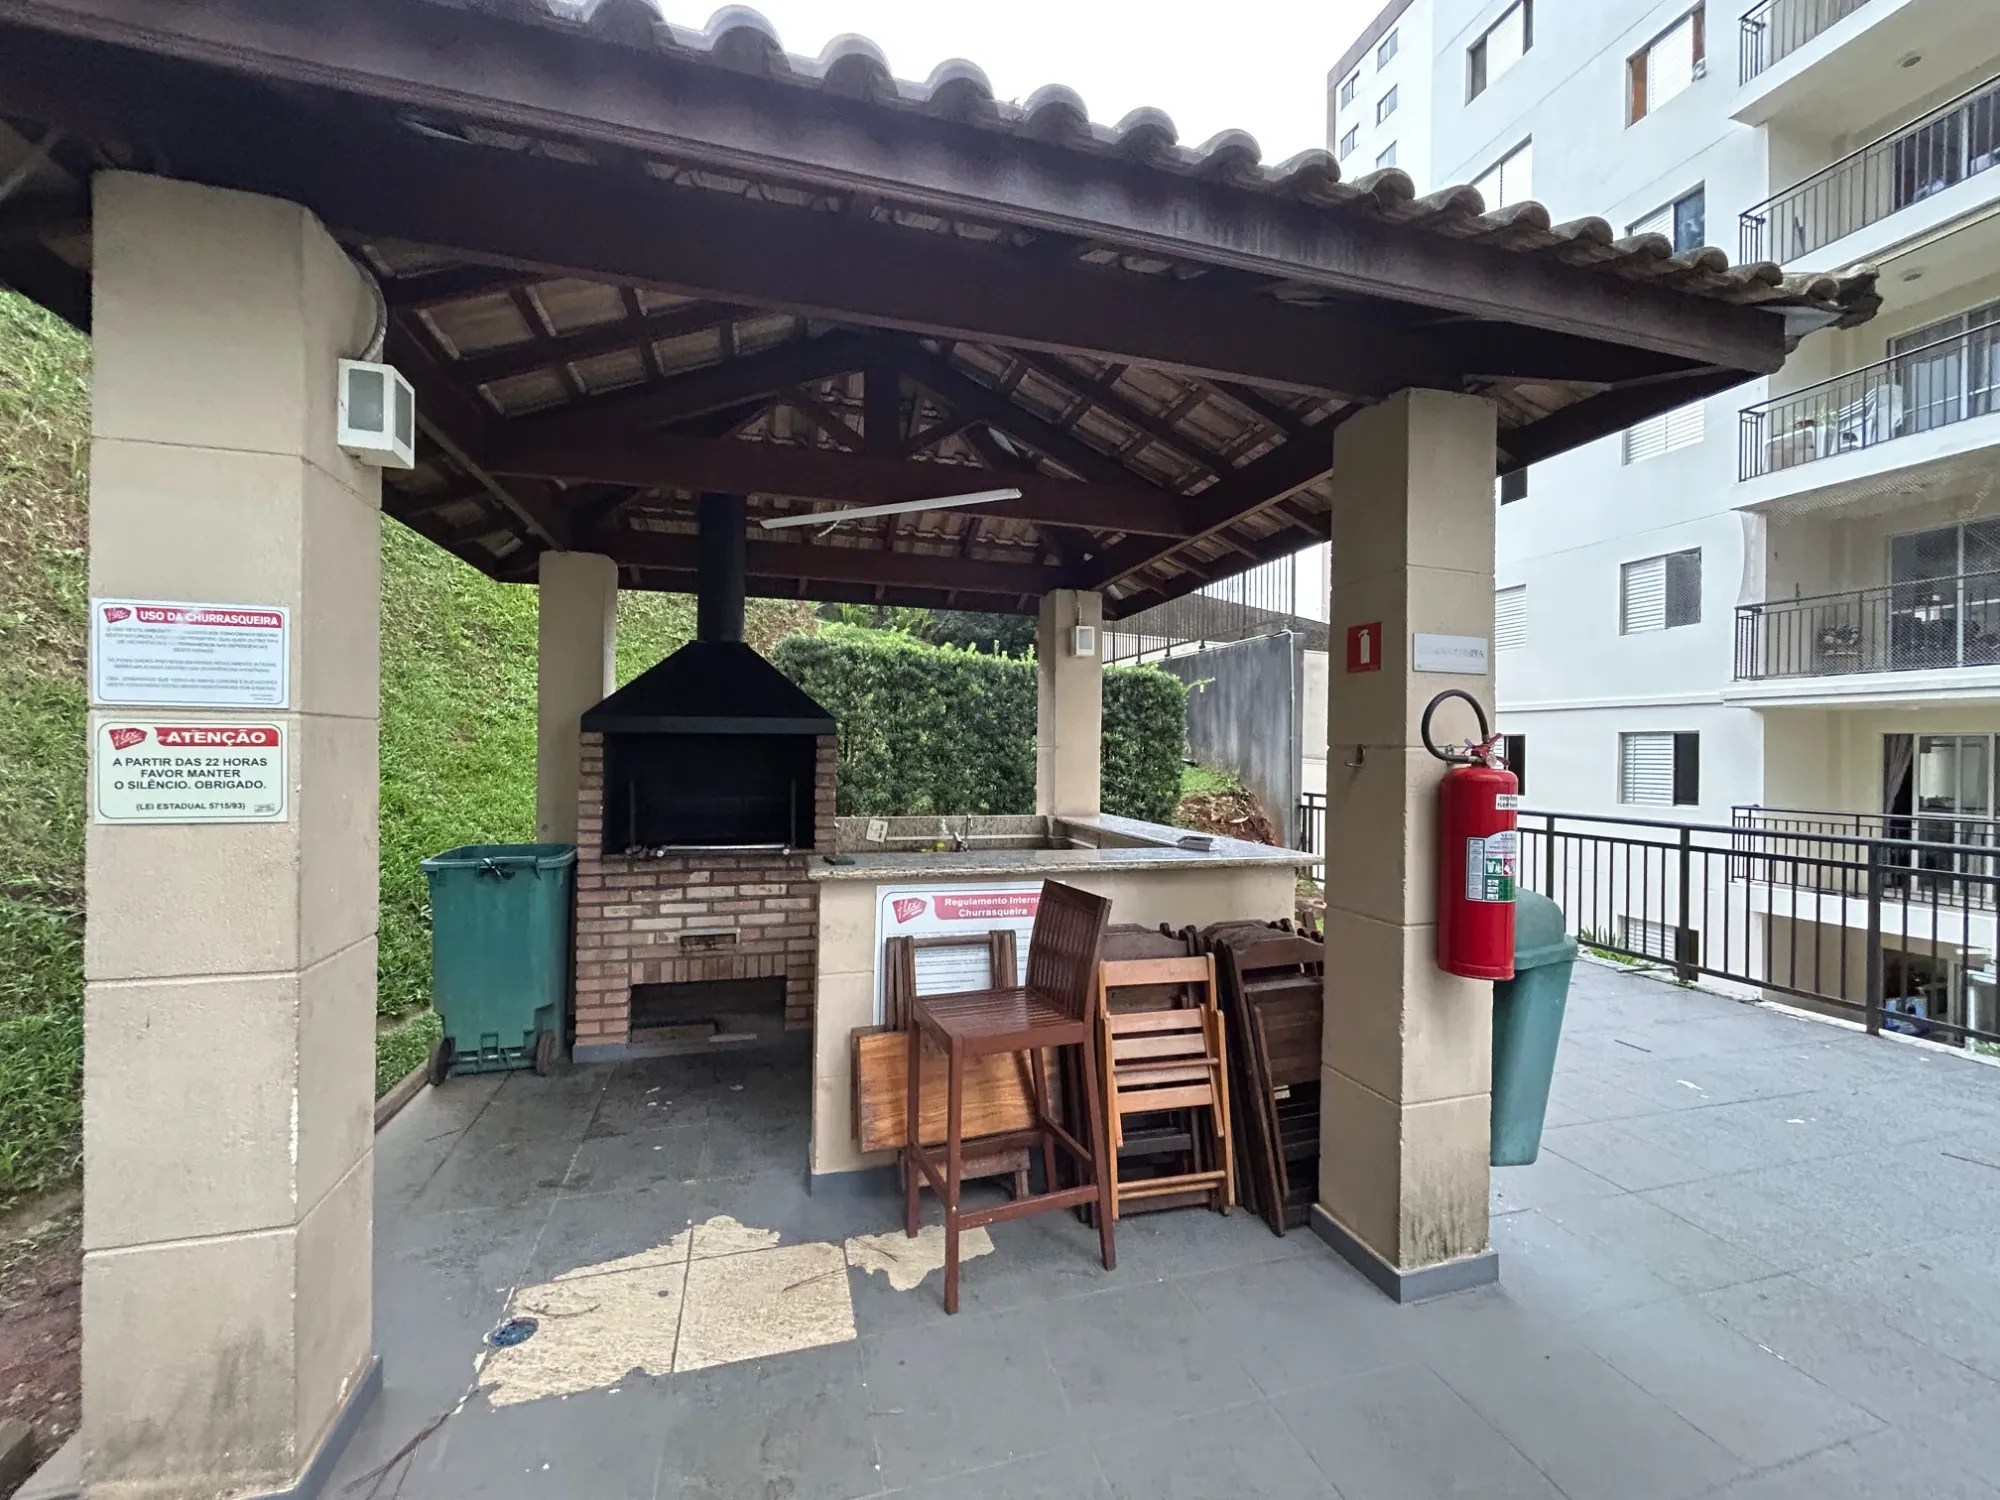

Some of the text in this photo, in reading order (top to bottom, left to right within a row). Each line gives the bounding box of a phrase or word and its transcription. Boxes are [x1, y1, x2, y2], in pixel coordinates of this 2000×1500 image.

[141, 611, 279, 625] USO DA CHURRASQUEIRA
[166, 729, 266, 746] ATENÇÃO
[113, 758, 267, 766] A PARTIR DAS 22 HORAS
[141, 769, 241, 778] FAVOR MANTER
[114, 779, 266, 789] O SILÊNCIO. OBRIGADO.
[136, 803, 154, 811] (LEI
[209, 802, 246, 810] 5715/93)
[945, 897, 1008, 907] Regulamento
[958, 908, 1028, 917] Churrasqueira
